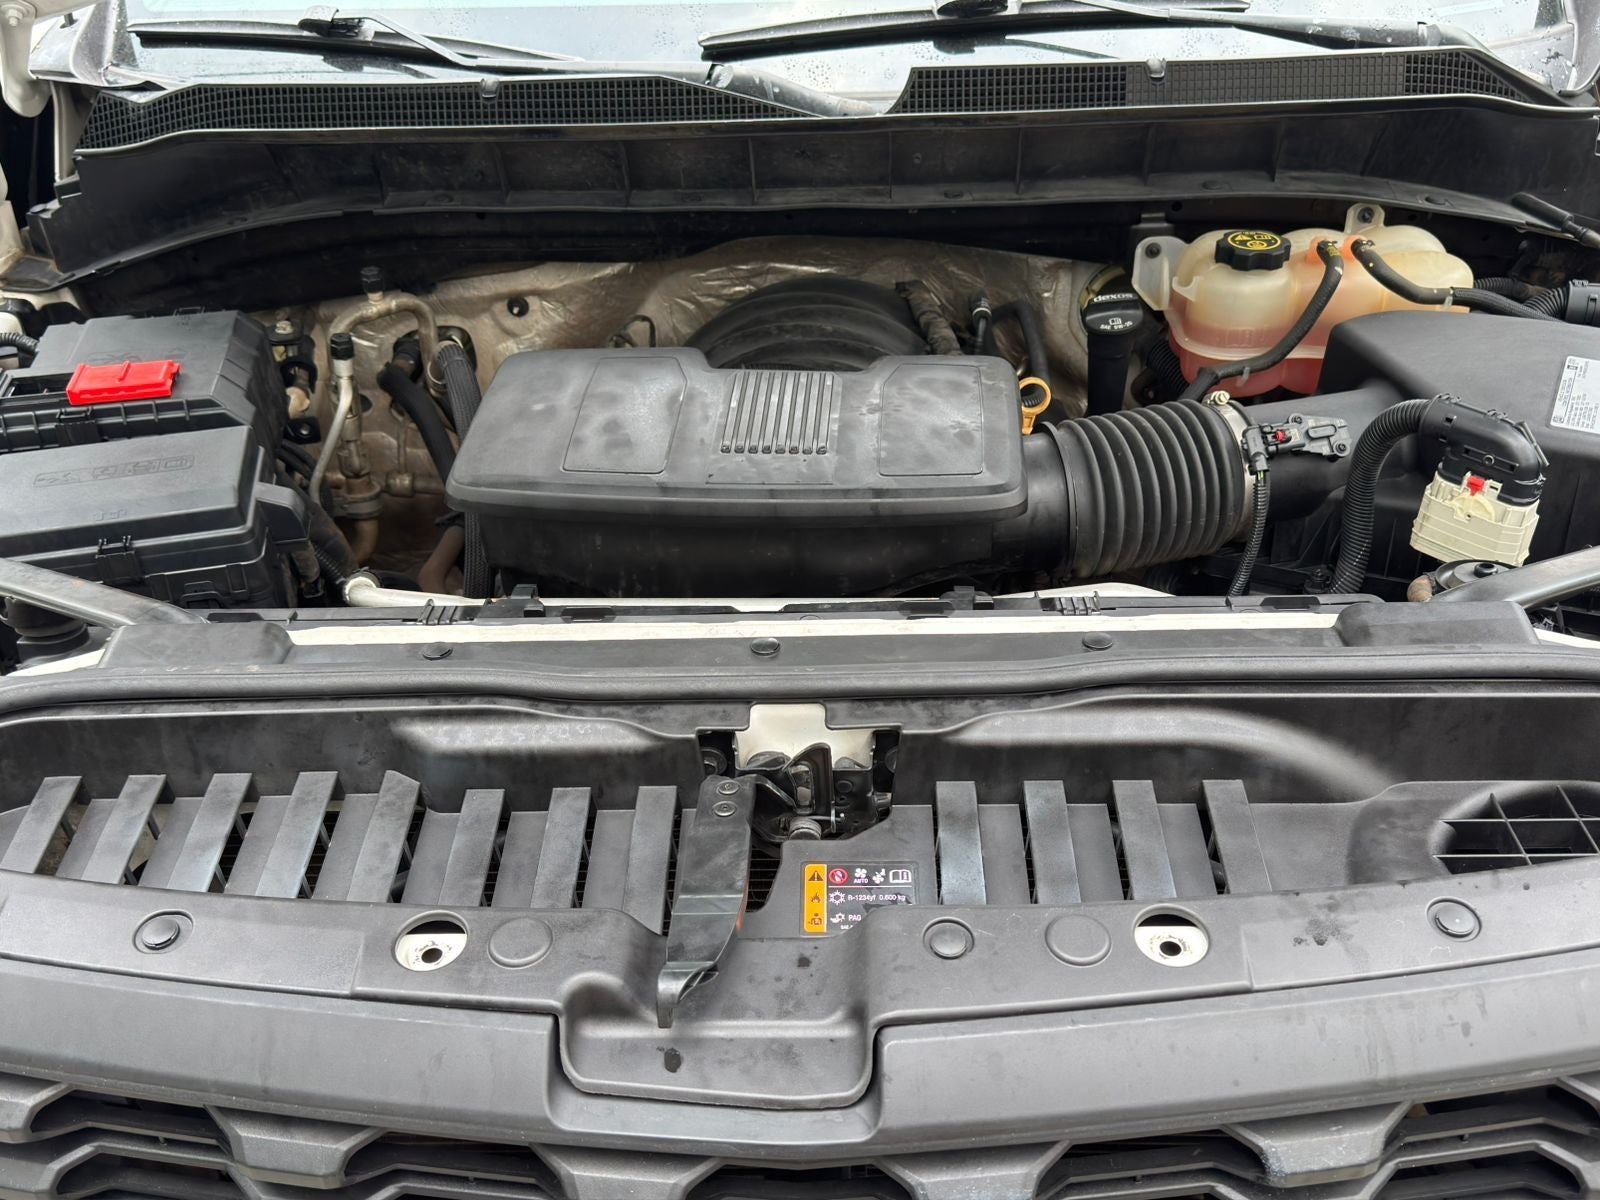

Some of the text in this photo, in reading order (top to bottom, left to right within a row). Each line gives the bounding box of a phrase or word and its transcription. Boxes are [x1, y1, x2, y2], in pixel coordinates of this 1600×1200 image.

[1093, 293, 1133, 303] dexos
[847, 894, 876, 902] R-1234yf
[897, 894, 906, 902] kg
[848, 914, 862, 922] PAG
